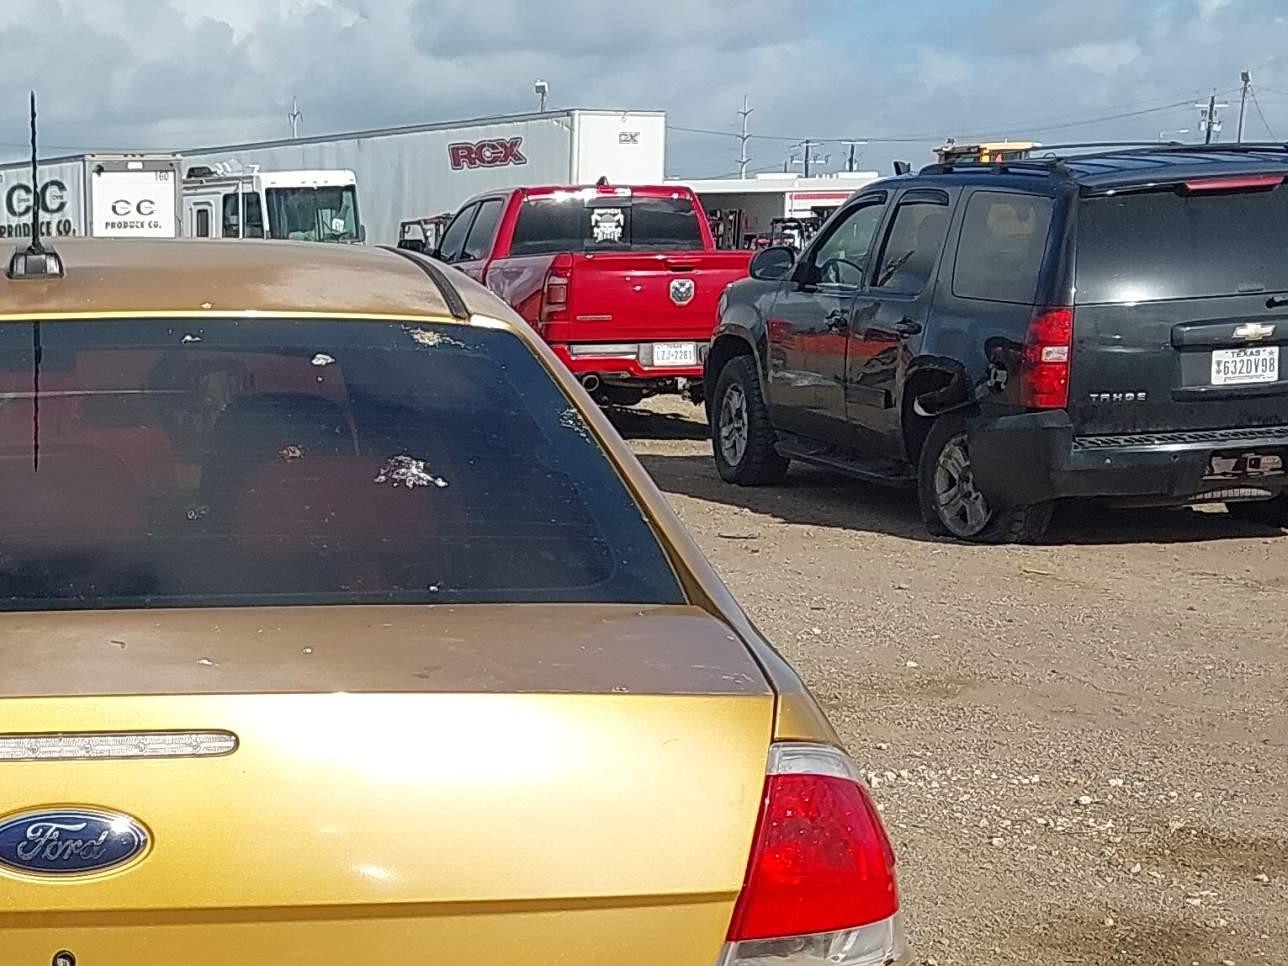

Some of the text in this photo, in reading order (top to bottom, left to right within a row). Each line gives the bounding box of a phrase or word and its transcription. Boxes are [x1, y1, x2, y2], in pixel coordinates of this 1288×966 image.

[448, 138, 528, 171] RCX
[105, 221, 145, 231] PRODUCE
[1231, 350, 1261, 358] TEXAS
[1090, 392, 1146, 401] TAHOE
[16, 821, 108, 862] Ford
